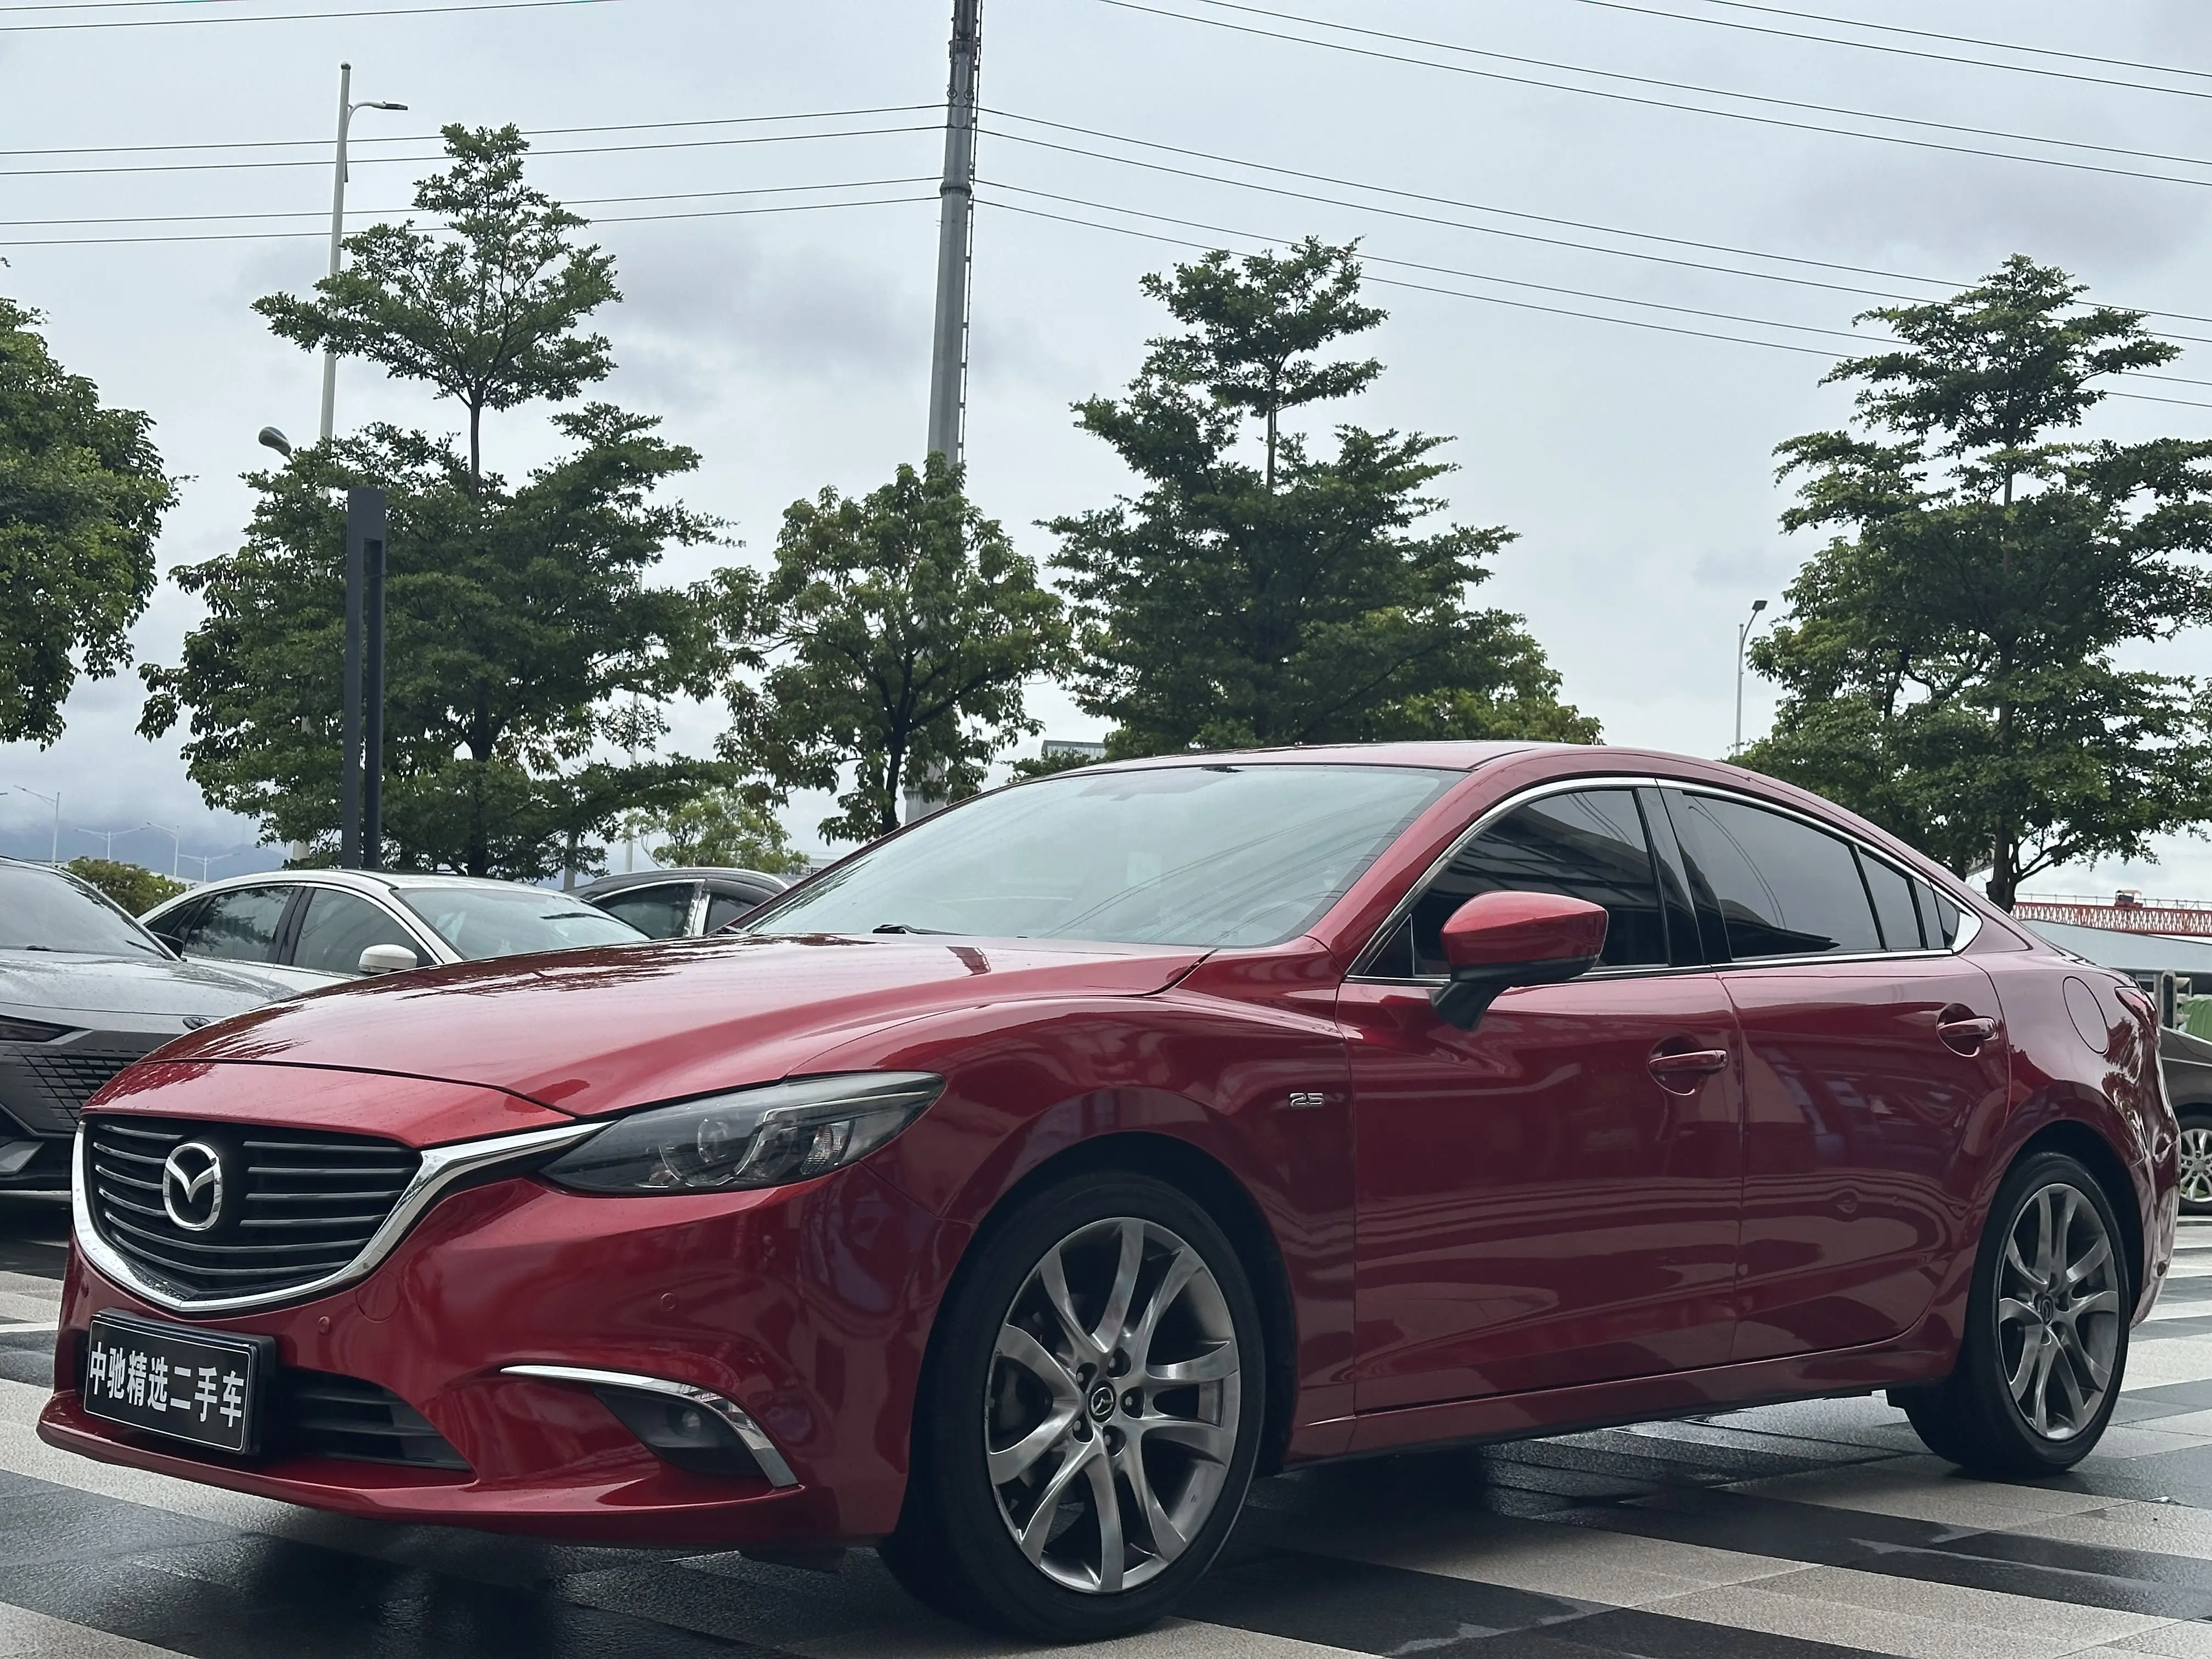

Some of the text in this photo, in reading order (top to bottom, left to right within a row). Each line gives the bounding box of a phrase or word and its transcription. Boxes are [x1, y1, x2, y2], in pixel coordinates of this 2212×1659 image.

[89, 1342, 244, 1427] 中驰精选二手车
